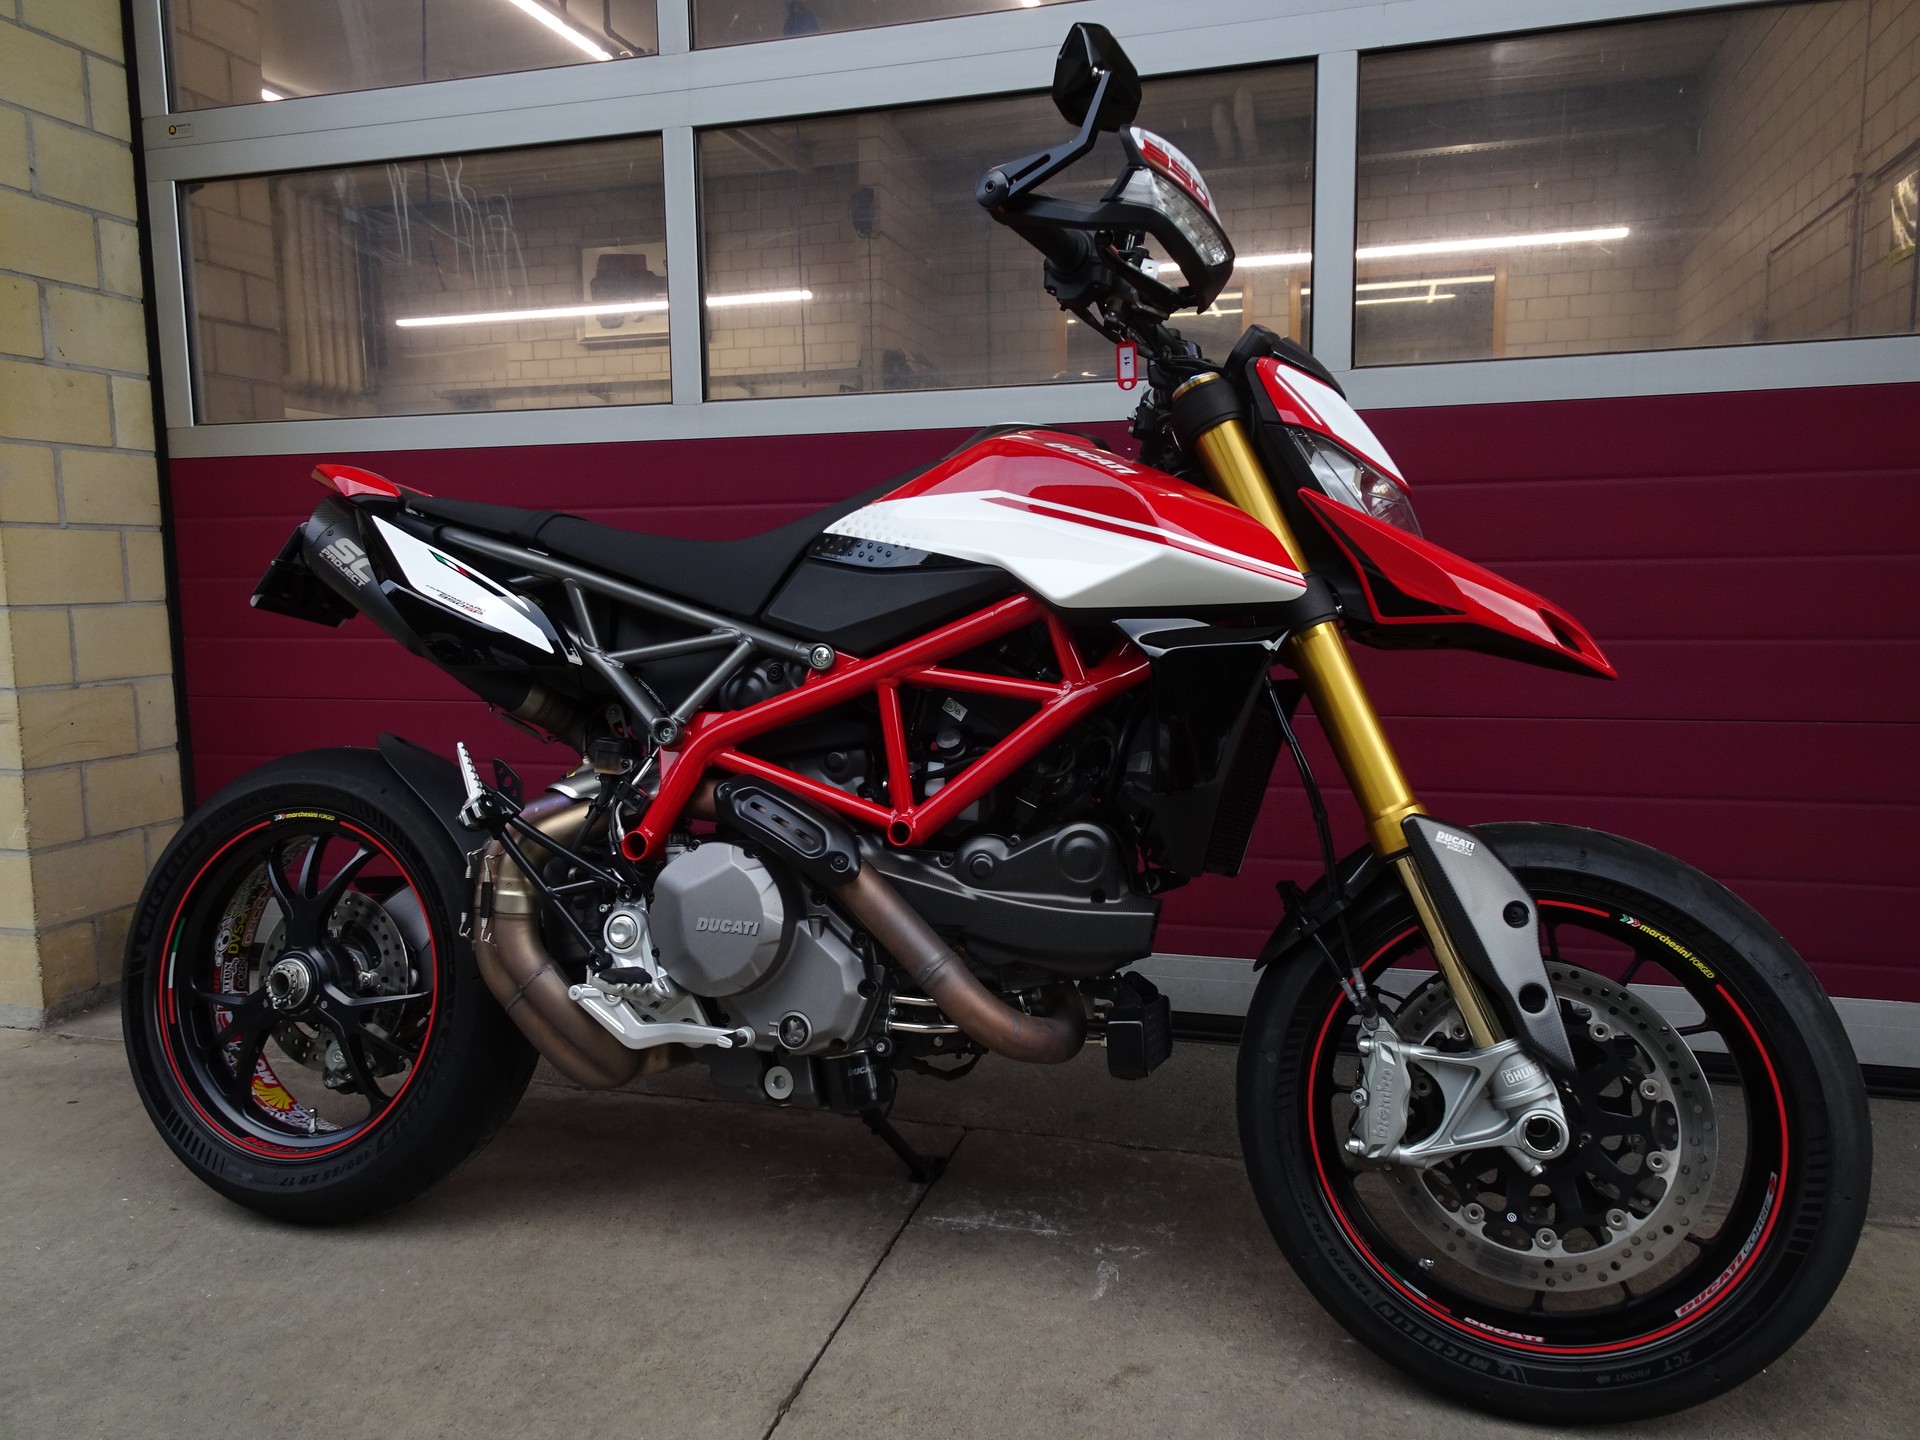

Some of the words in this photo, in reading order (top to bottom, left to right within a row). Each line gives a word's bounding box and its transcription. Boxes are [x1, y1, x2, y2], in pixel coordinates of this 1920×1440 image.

[1123, 356, 1131, 366] 11
[1044, 442, 1139, 475] DUCATI
[320, 547, 366, 587] PROJECT
[286, 811, 318, 819] marchesini
[318, 813, 336, 821] FORGED
[1435, 830, 1476, 851] DUCATI
[695, 917, 761, 937] DUCATI
[1639, 924, 1692, 959] marchesini
[1688, 956, 1715, 979] FORGED
[848, 1064, 878, 1077] DUCATI
[1504, 1061, 1541, 1084] ÖHLINS
[1371, 1068, 1394, 1139] brembo
[1327, 1247, 1372, 1296] 120/70
[1679, 1254, 1743, 1315] DUCATI
[1743, 1203, 1771, 1254] CORSE
[1377, 1303, 1491, 1371] MICHELIN
[1463, 1317, 1546, 1344] DUCATI
[1613, 1367, 1651, 1381] FRONT
[1662, 1350, 1693, 1373] 2CT
